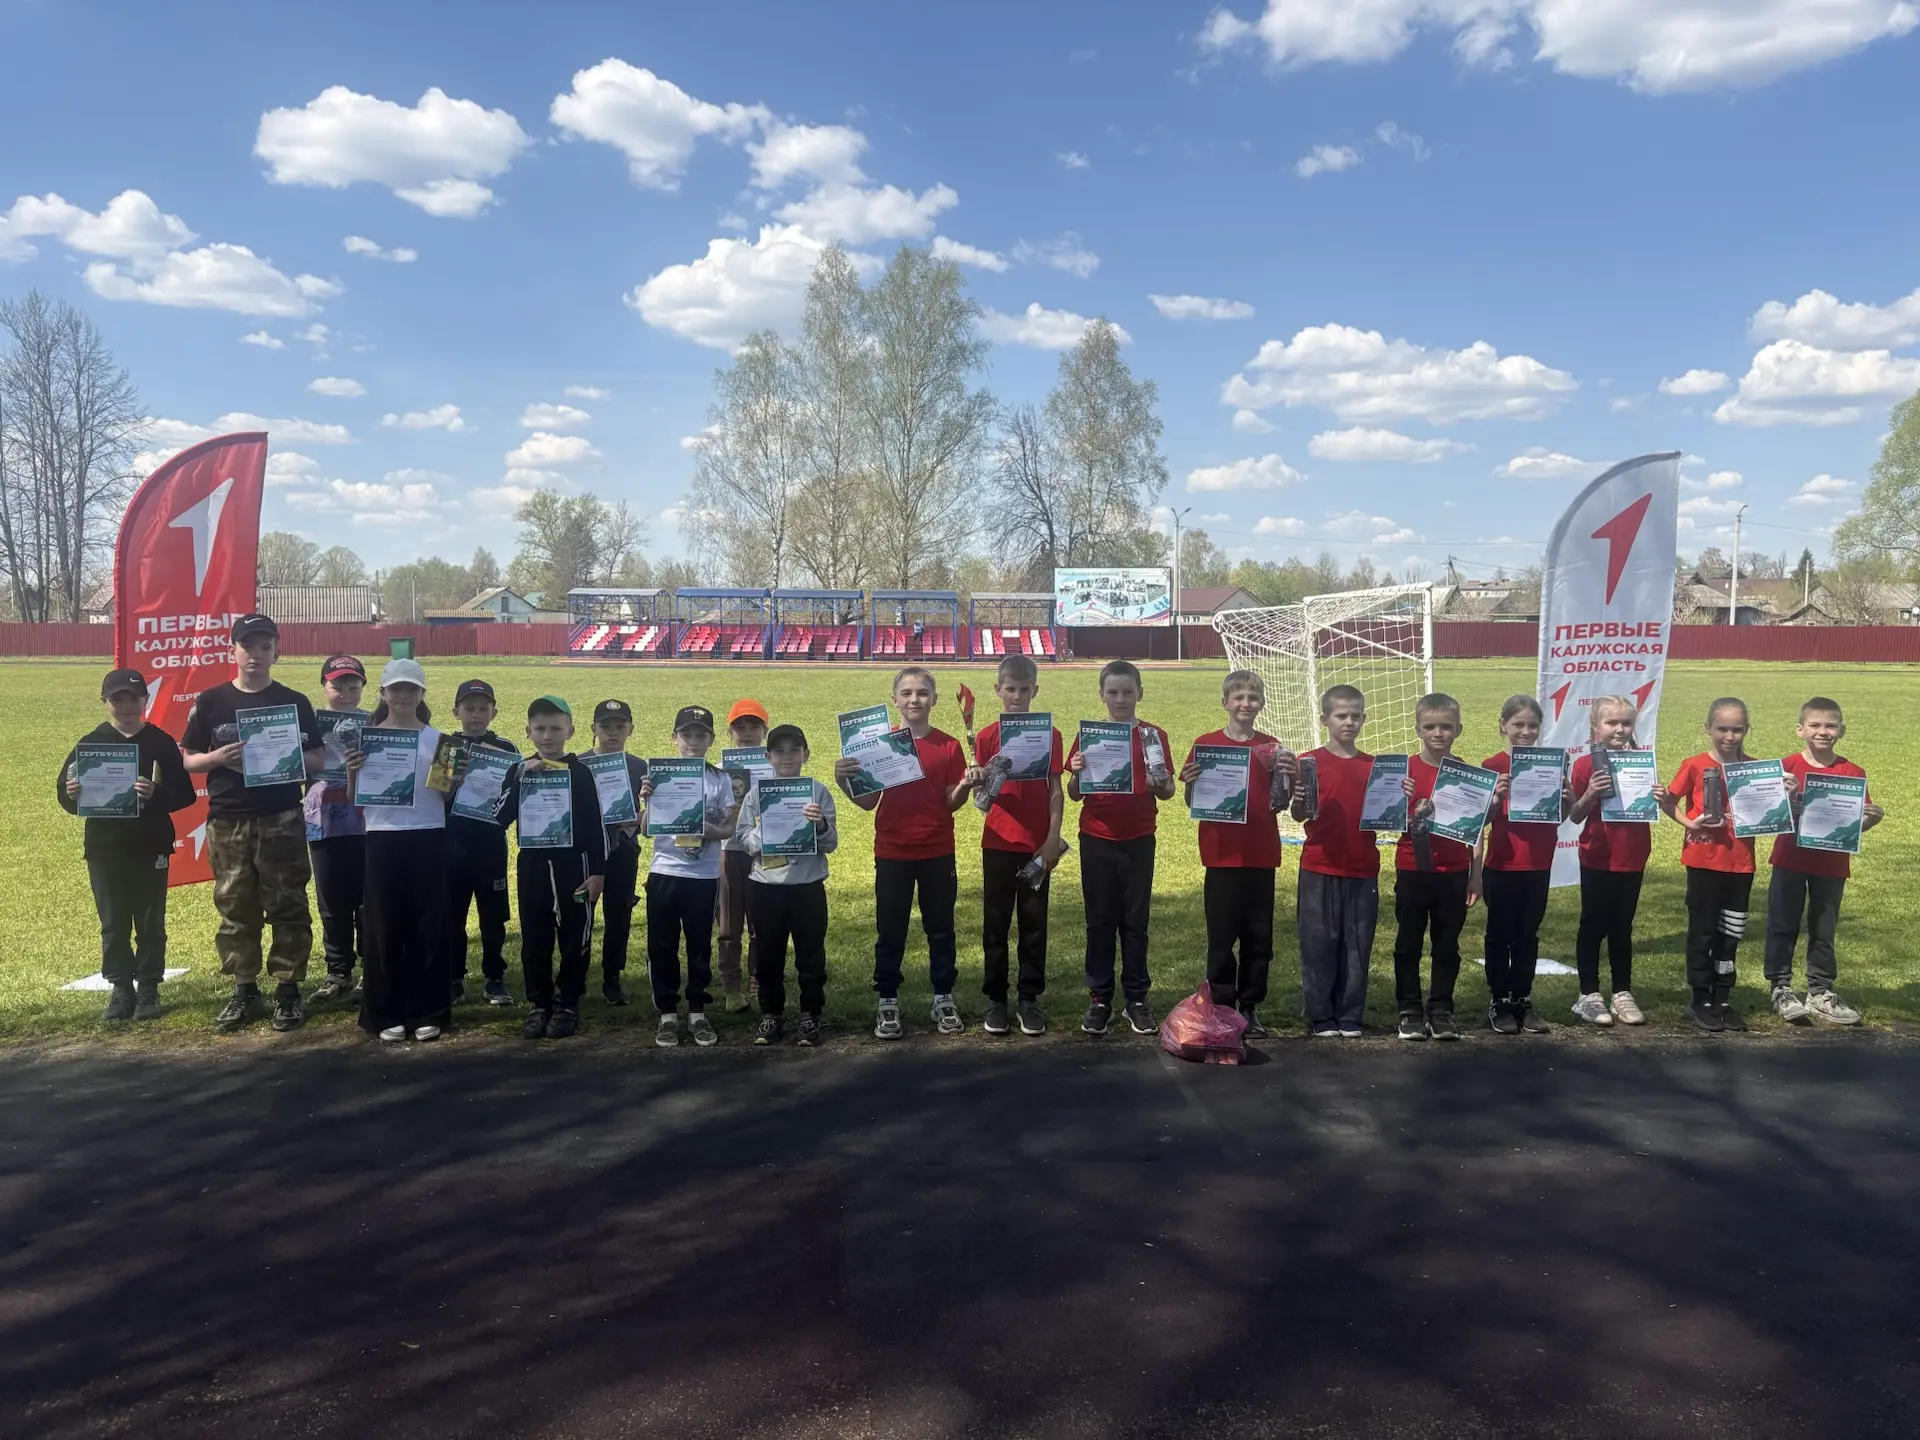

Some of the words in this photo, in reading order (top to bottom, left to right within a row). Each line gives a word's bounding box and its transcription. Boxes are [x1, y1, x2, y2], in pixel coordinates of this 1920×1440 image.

[1555, 622, 1662, 641] ПЕРВЫЕ
[134, 635, 233, 652] КАЛУЖСК
[1550, 643, 1663, 659] КАЛУЖСКАЯ
[150, 652, 237, 669] ОБЛАСТЬ
[1562, 660, 1647, 674] ОБЛАСТЬ
[240, 713, 294, 723] СЕРТИФИКАТ
[841, 712, 886, 727] СЕРТИФИКАТ
[1081, 727, 1129, 736] СЕРТИФИКАТ
[363, 735, 417, 743] СЕРТИФИКАТ
[844, 738, 880, 756] ДИПЛОМ
[724, 753, 766, 761] СЕРТИФИКА
[1196, 752, 1248, 760] СЕРТИФИКАТ
[1513, 753, 1562, 761] СЕРТИФИКАТ
[588, 759, 623, 770] ТИФИКАТ
[1442, 765, 1494, 785] СЕРТИФИКАТ
[1726, 766, 1781, 777] СЕРТИФИКАТ
[760, 785, 812, 793] СЕРТИФИКАТ
[1807, 780, 1863, 792] СЕРТИФИКАТ
